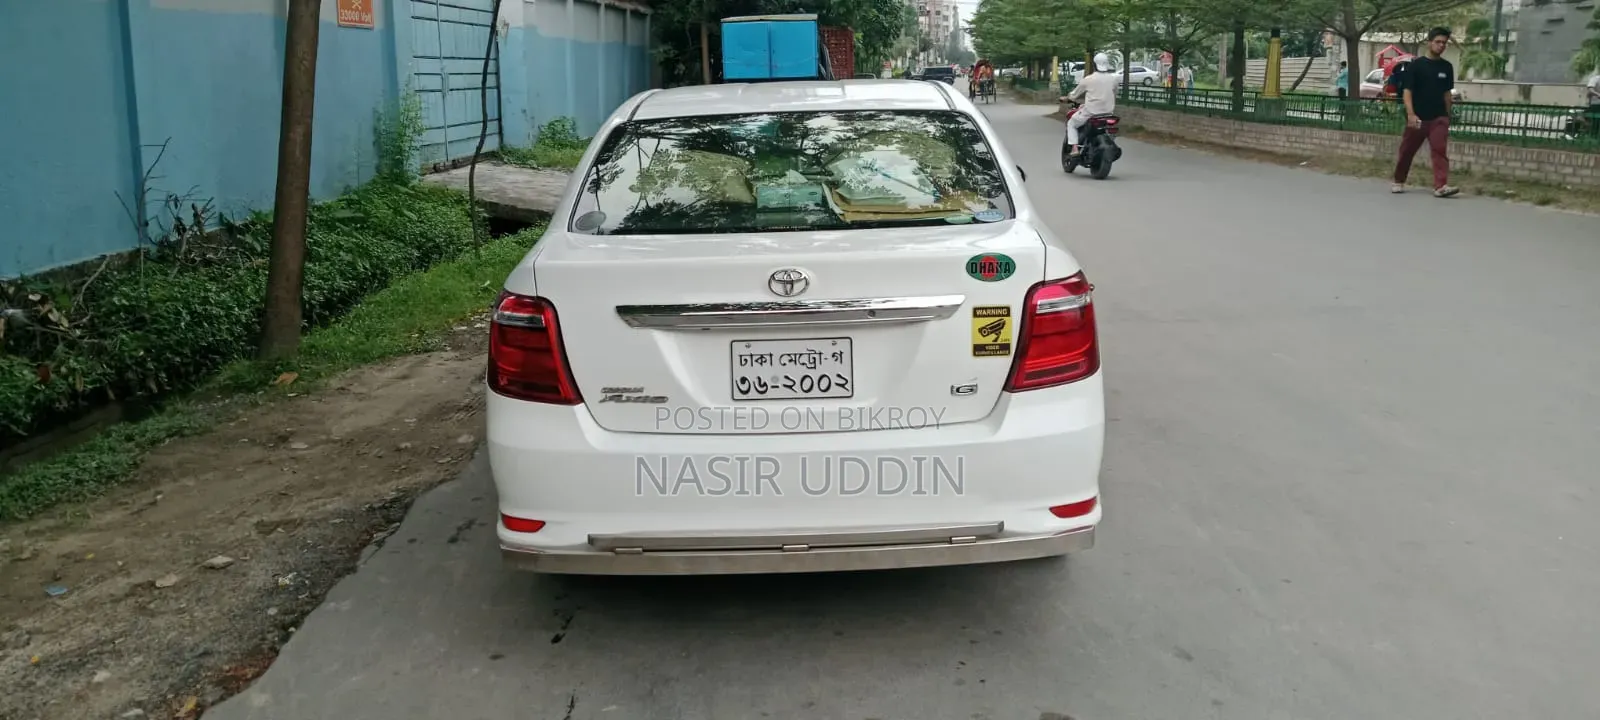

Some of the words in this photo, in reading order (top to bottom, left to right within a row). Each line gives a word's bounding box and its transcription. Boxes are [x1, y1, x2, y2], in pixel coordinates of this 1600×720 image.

[340, 9, 359, 21] 33000
[971, 261, 1011, 274] DHAKA
[976, 308, 1008, 316] WARNING
[738, 352, 774, 367] ঢাকা
[735, 373, 850, 395] ৩৬-২০০২
